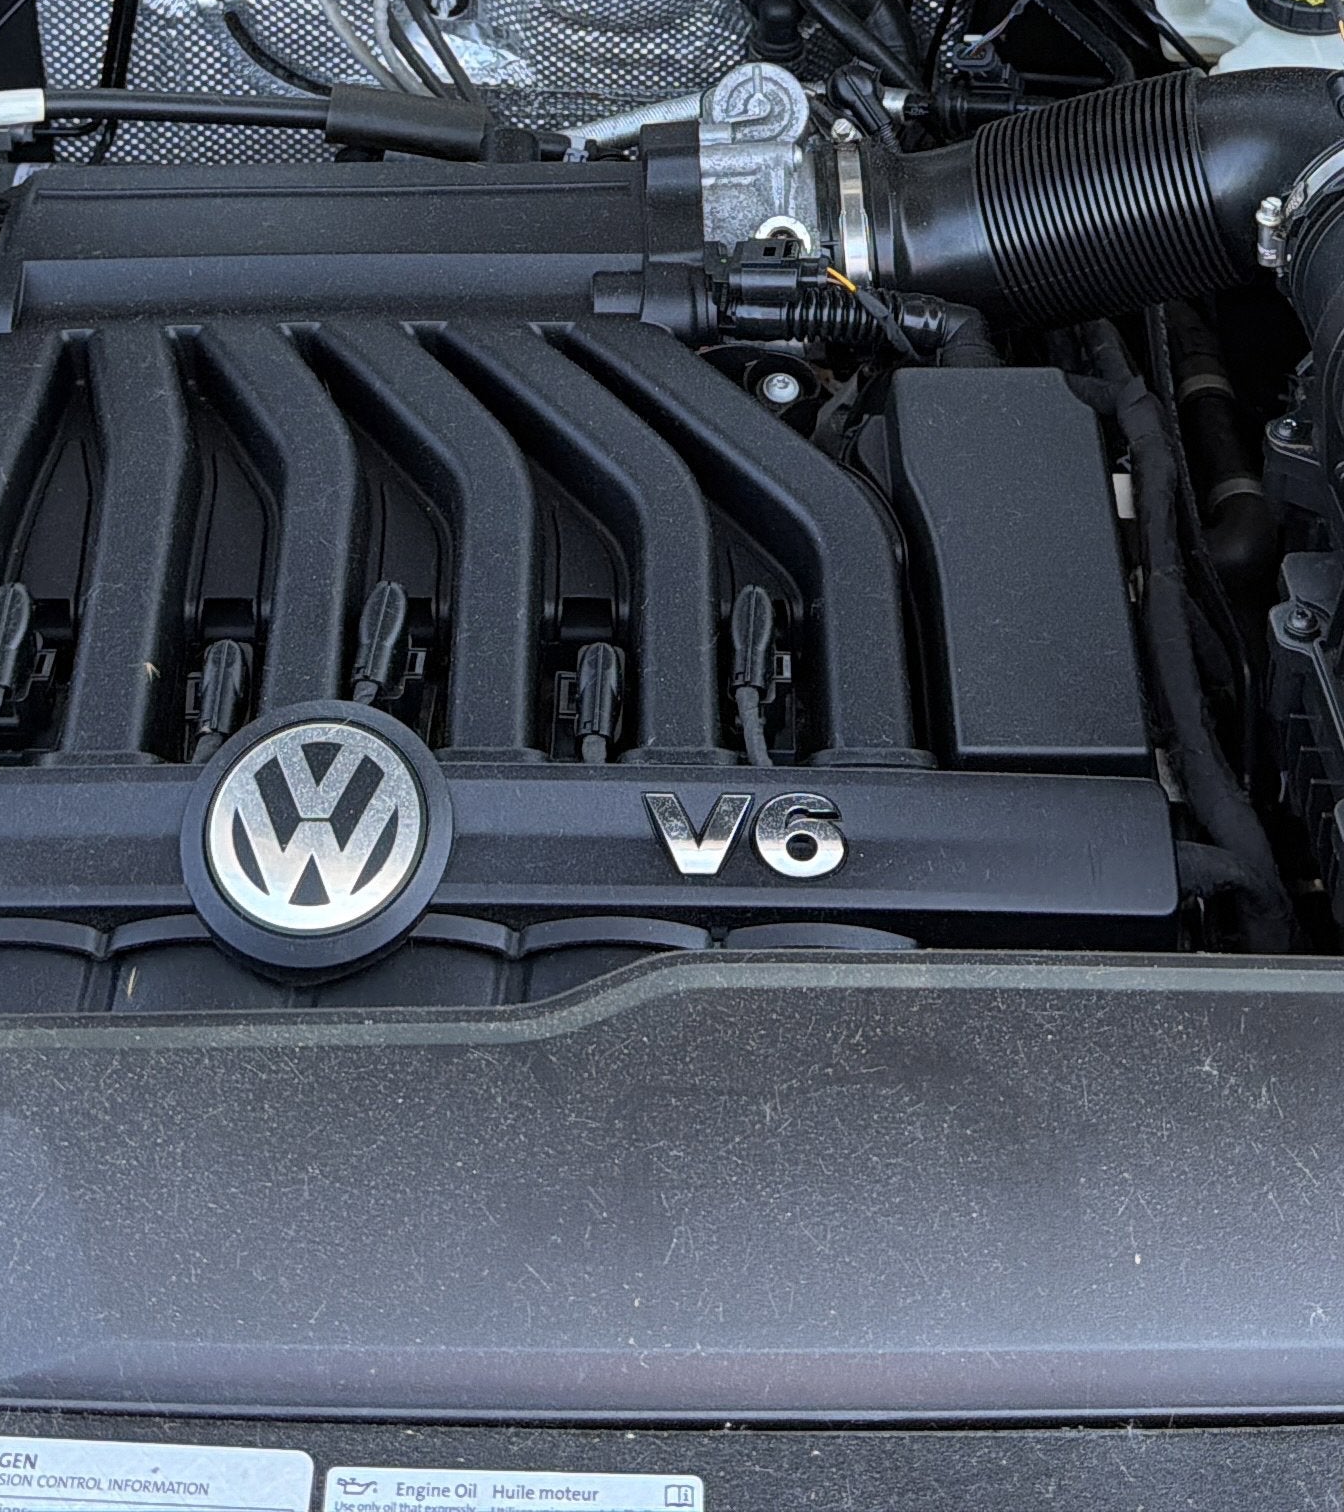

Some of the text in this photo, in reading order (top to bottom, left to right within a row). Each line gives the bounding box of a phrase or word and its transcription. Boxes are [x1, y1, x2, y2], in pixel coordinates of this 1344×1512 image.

[641, 790, 850, 880] V6
[36, 1475, 105, 1491] CONTROL
[107, 1478, 210, 1496] INFORMATION
[396, 1481, 599, 1502] Engine Oil Huile moteur
